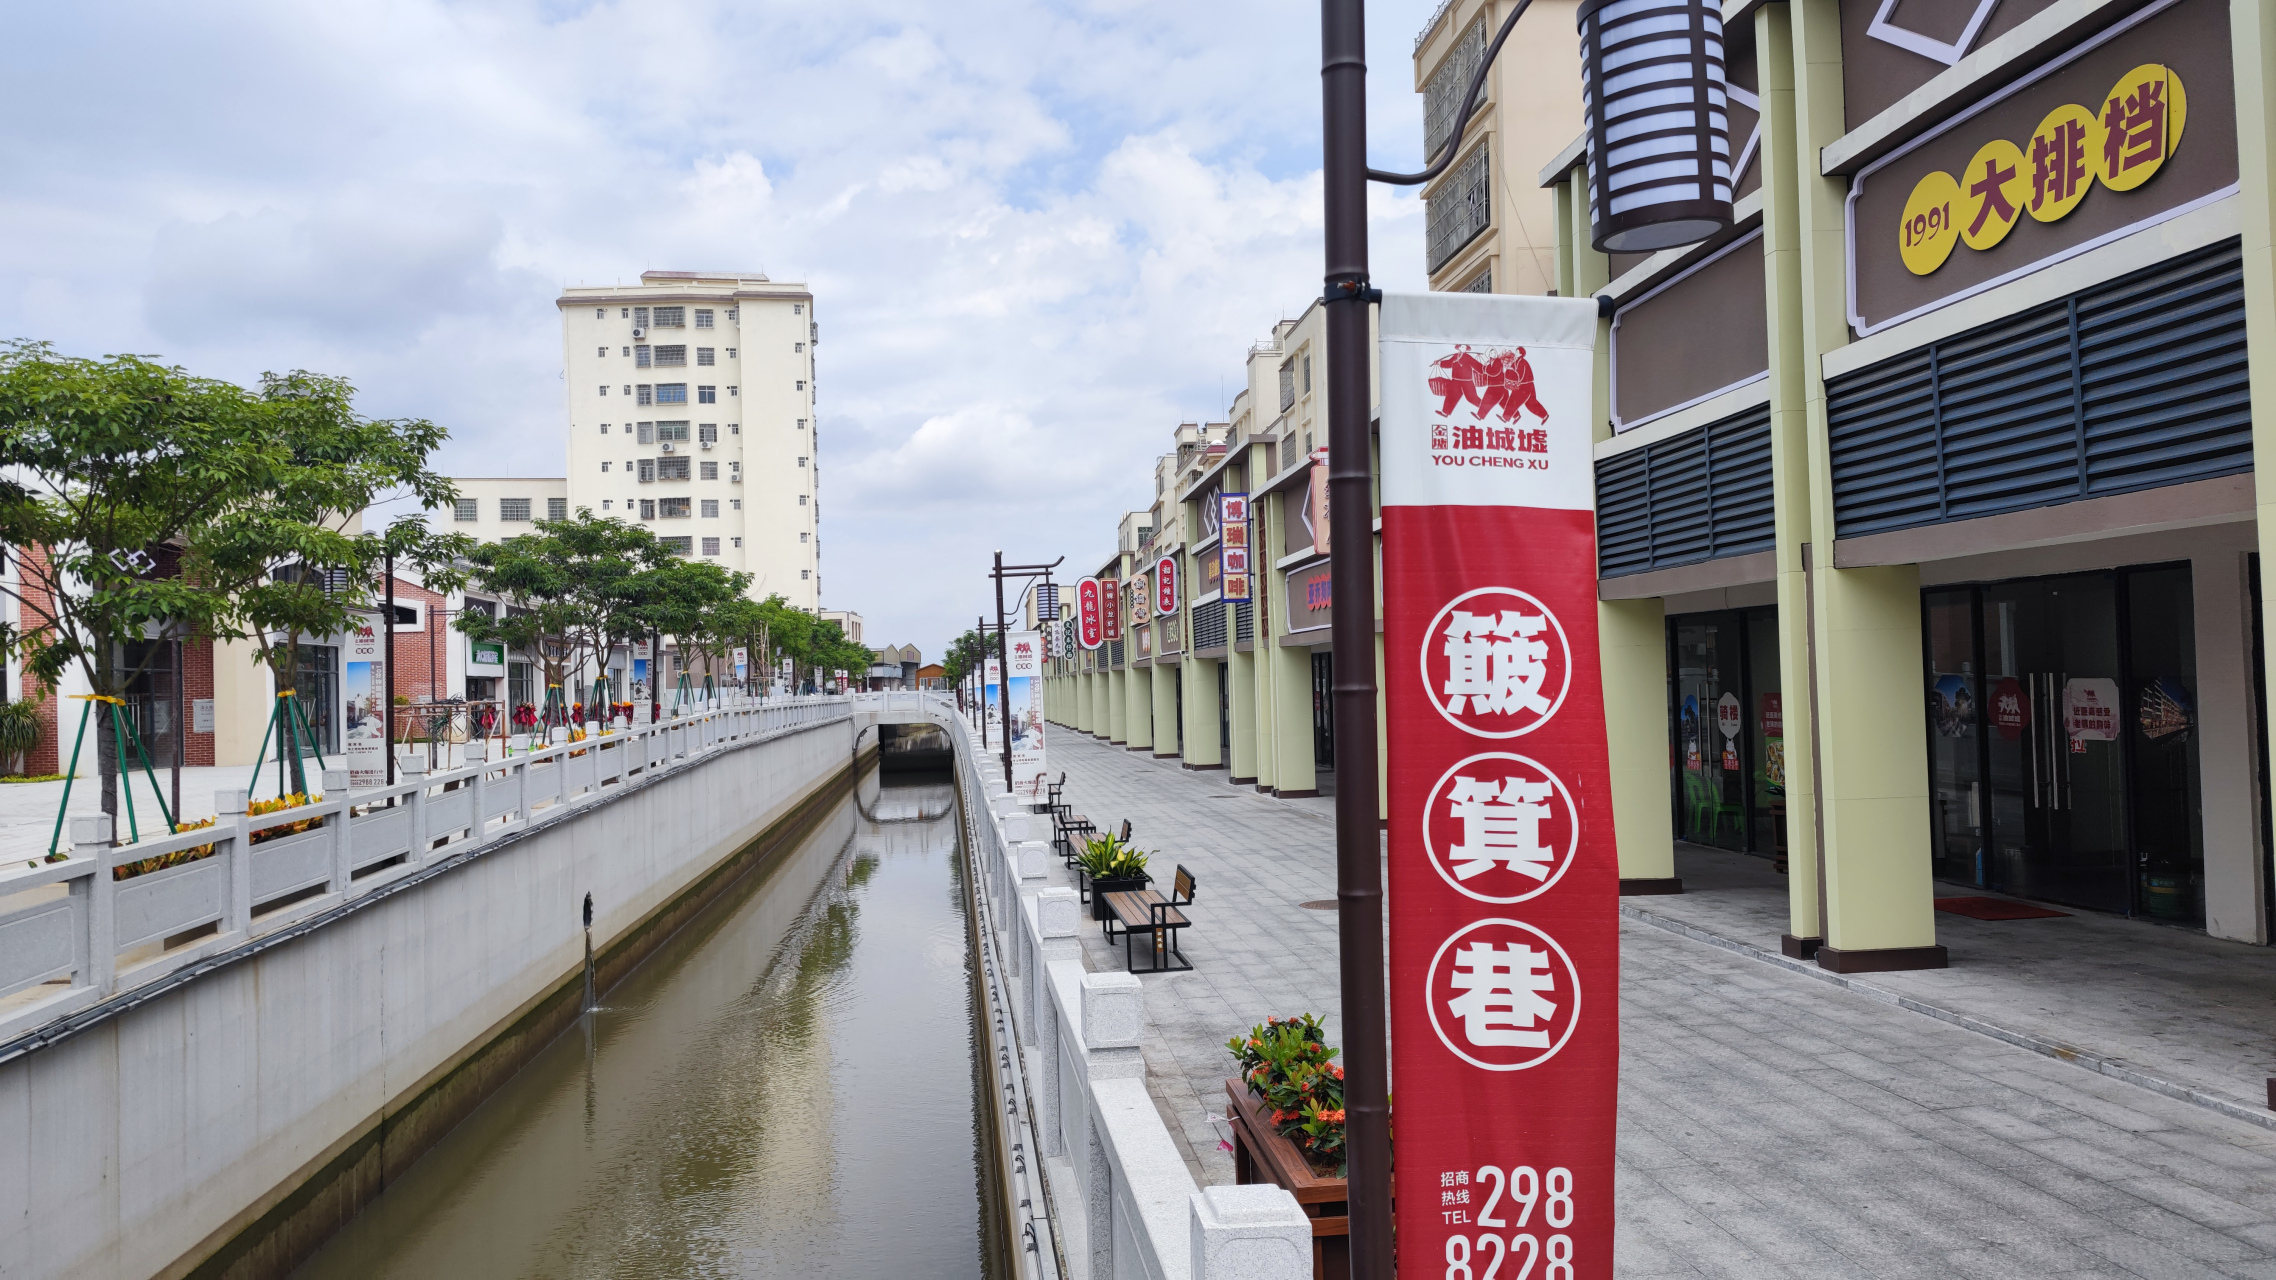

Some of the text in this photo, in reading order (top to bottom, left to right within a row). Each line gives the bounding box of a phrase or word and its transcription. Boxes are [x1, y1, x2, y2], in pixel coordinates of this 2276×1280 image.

[1904, 80, 2165, 247] 1991 大排档
[1432, 455, 1549, 470] YOU CHENG XU
[1452, 425, 1549, 454] 油城墟
[1226, 500, 1246, 596] 博瑞咖啡
[1443, 610, 1557, 1048] 簸箕巷
[1441, 1165, 1574, 1229] 招商 298
[1441, 1189, 1470, 1207] 热线
[1441, 1209, 1472, 1225] TEL
[1445, 1233, 1574, 1280] 8228
